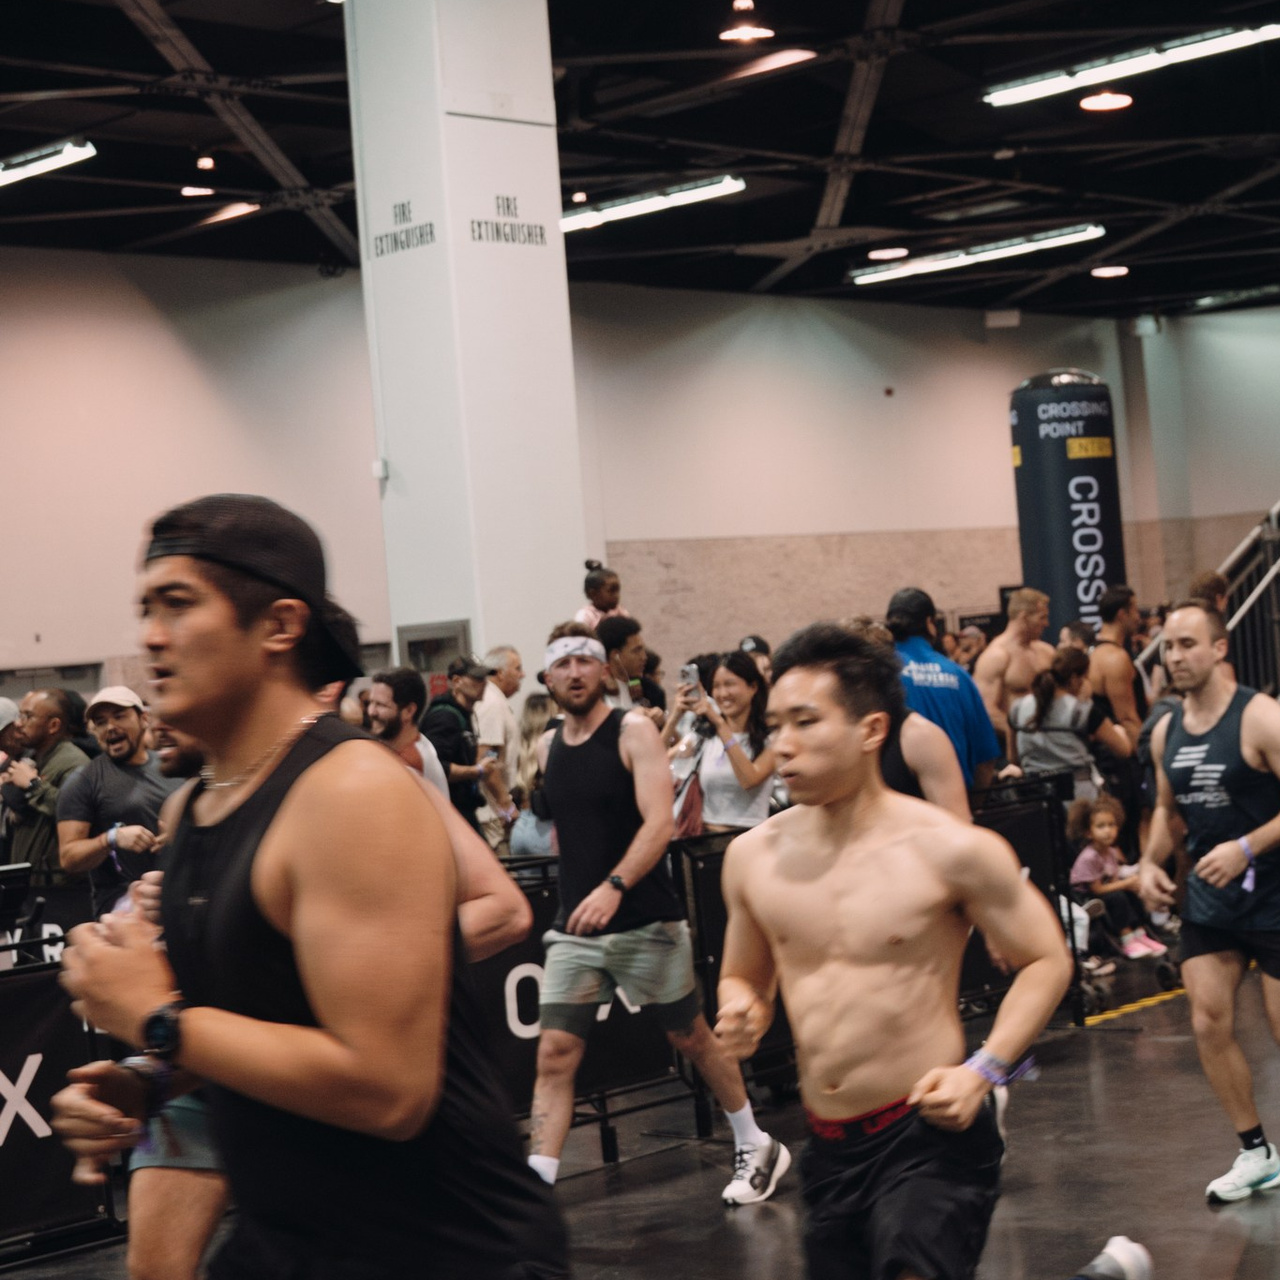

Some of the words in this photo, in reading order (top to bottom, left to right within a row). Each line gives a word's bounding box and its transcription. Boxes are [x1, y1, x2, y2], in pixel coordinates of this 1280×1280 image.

[394, 200, 412, 225] FIRE
[495, 195, 519, 218] FIRE
[374, 223, 436, 257] EXTINGUISHER
[471, 219, 547, 246] EXTINGUISHER
[1039, 421, 1085, 439] POINT
